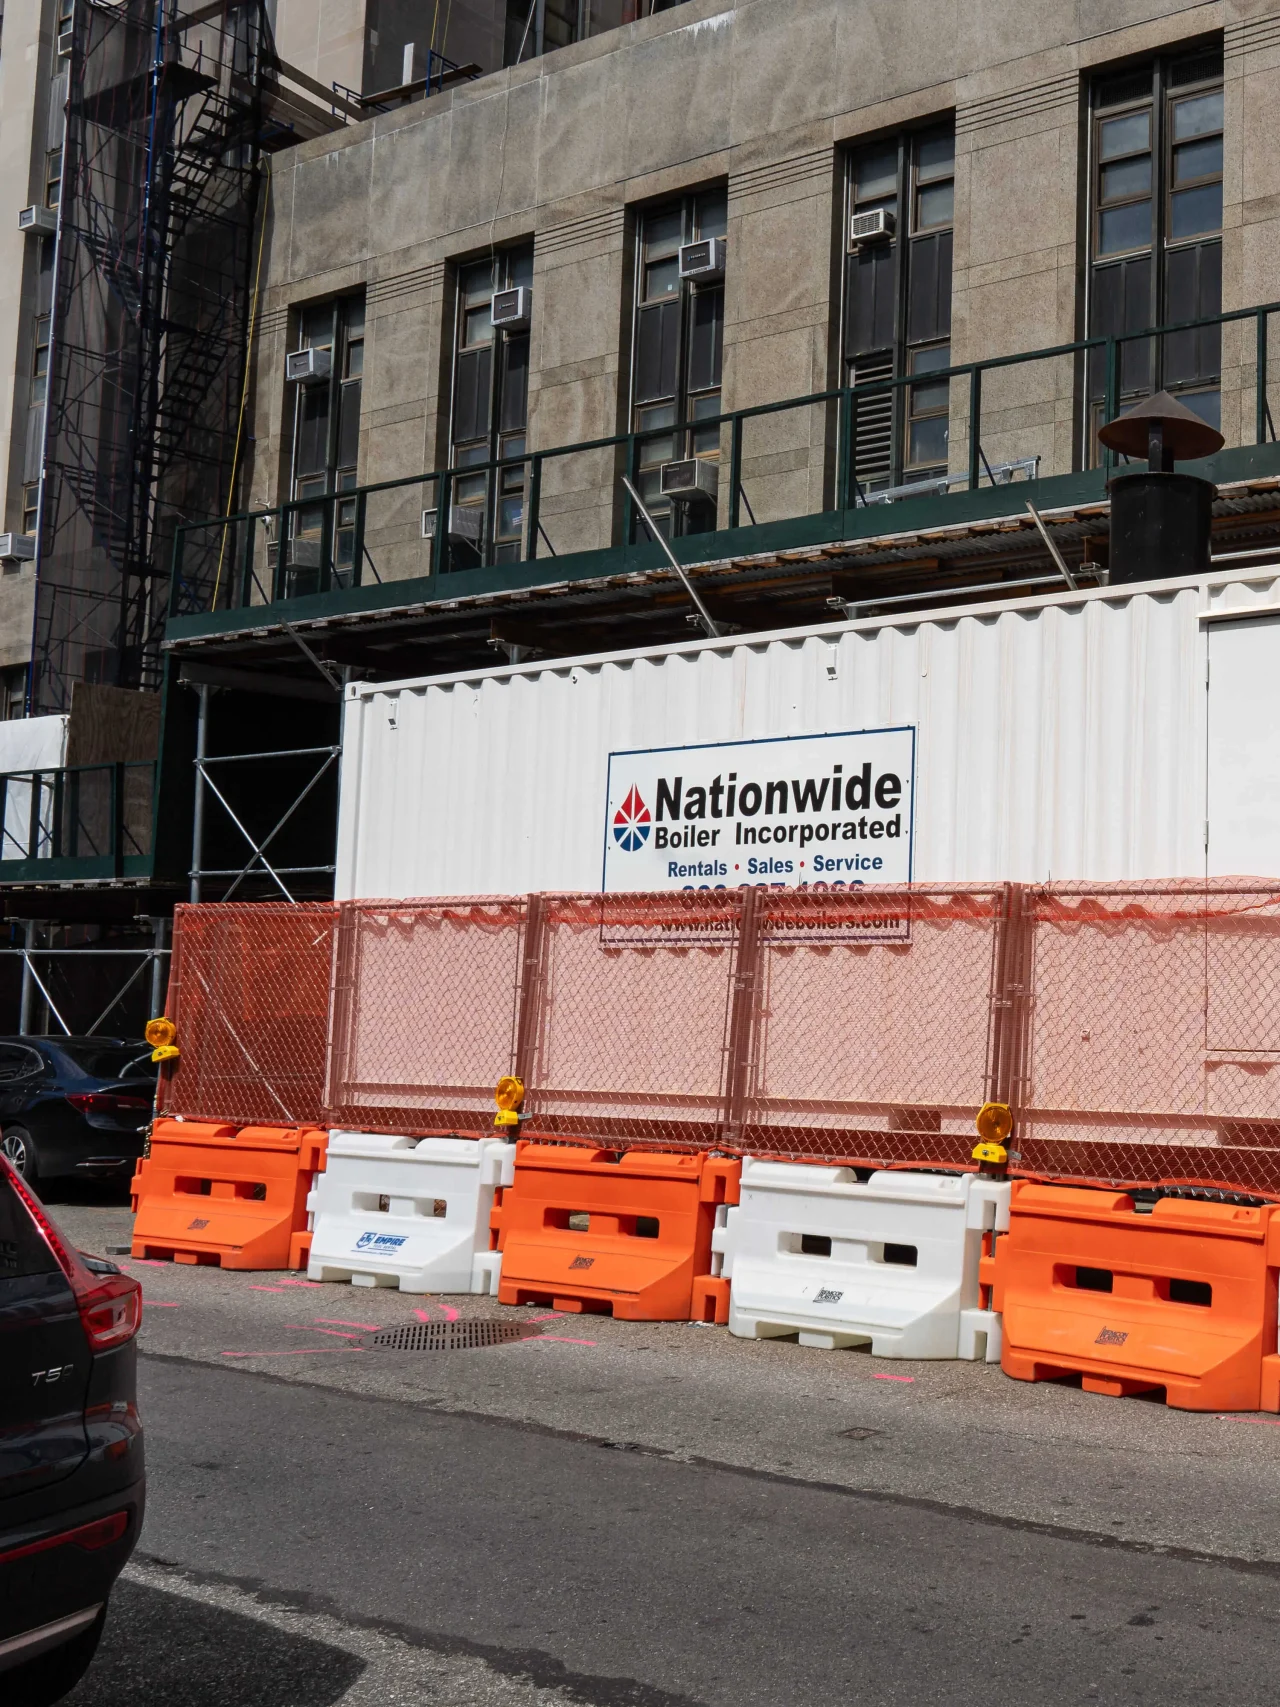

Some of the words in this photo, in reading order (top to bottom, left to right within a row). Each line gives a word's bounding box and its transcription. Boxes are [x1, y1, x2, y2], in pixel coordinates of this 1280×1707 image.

[655, 762, 902, 822] Nationwide
[654, 824, 721, 850] Boiler
[735, 813, 902, 849] Incorporated
[667, 860, 728, 878] Rentals
[747, 857, 794, 875] Sales
[813, 853, 884, 872] Service
[374, 1236, 406, 1246] EMPIRE
